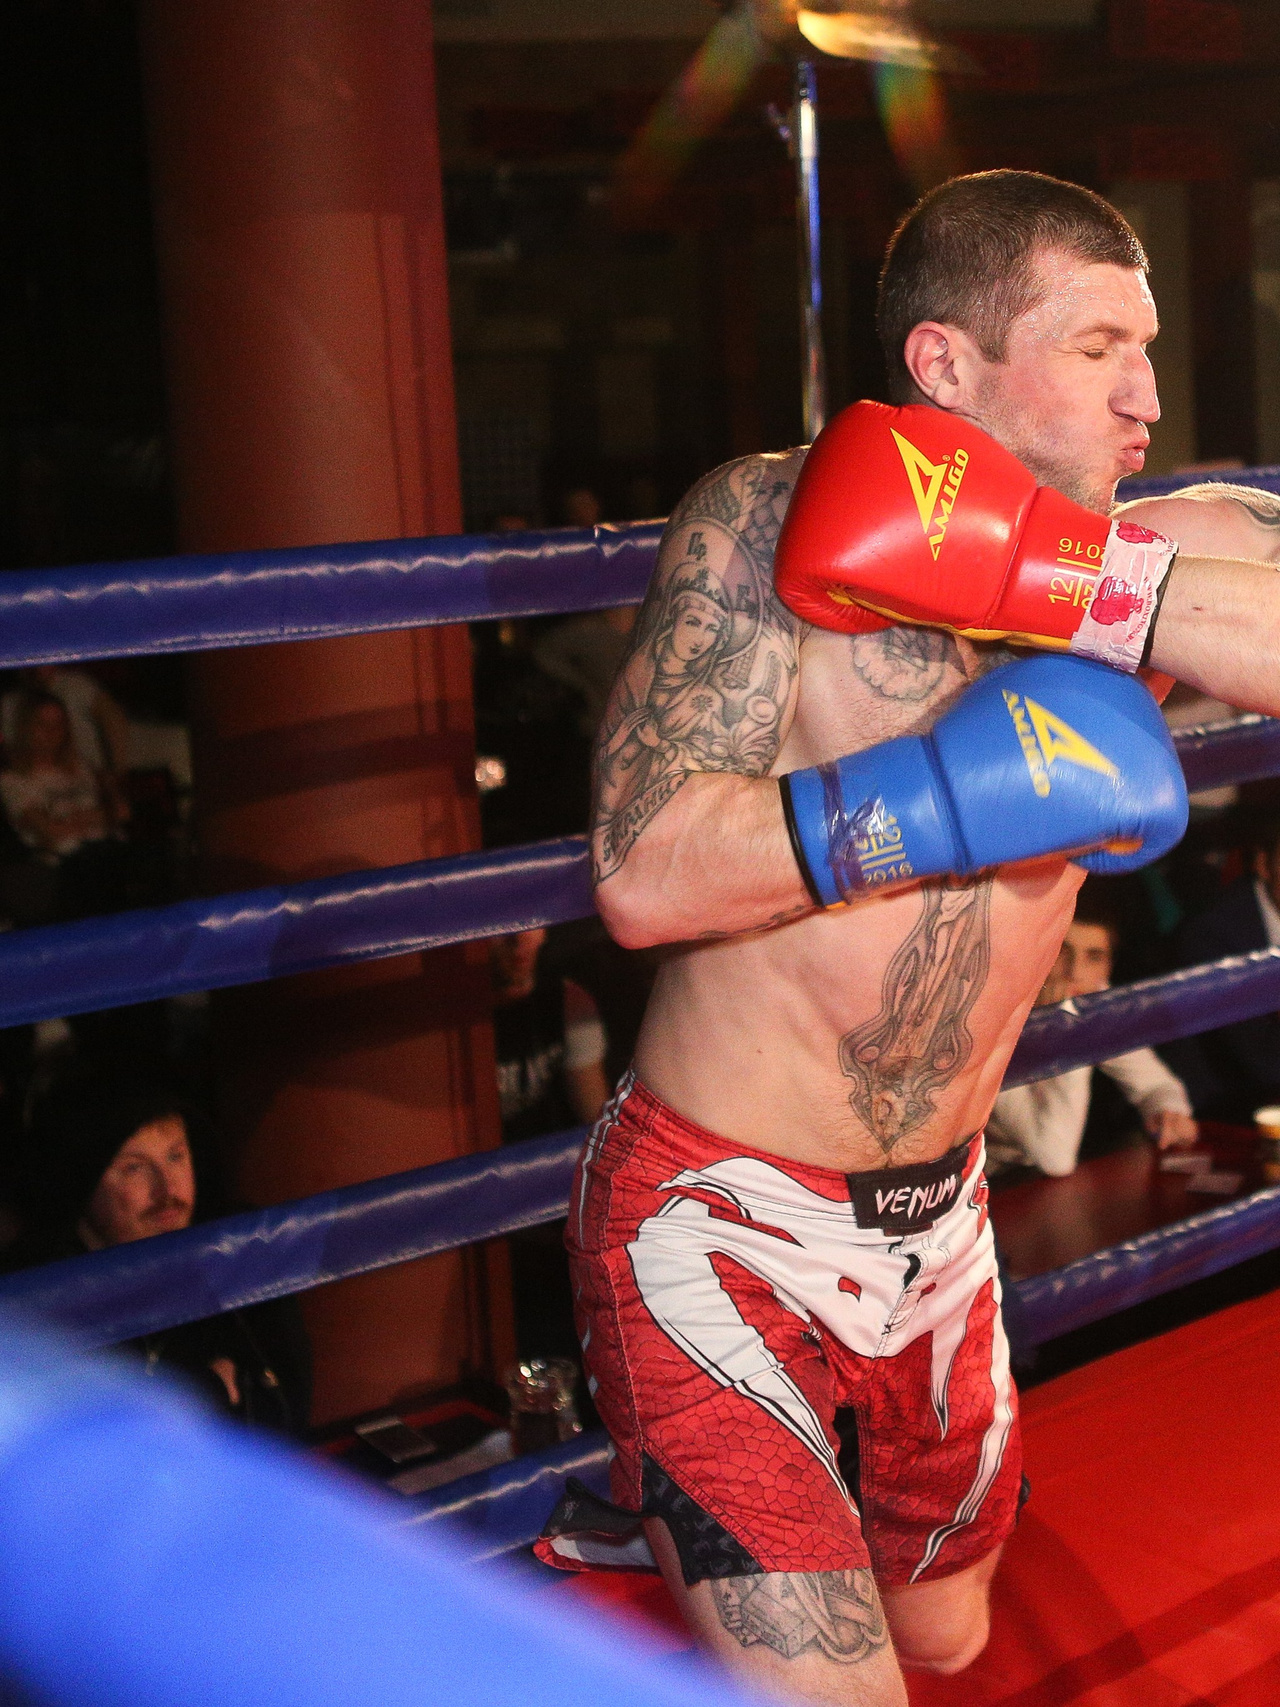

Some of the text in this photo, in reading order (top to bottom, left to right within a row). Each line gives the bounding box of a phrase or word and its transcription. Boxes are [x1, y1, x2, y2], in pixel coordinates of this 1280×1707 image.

[929, 448, 970, 561] AMIGO
[1048, 576, 1075, 604] 12
[875, 1174, 957, 1221] VENUM
